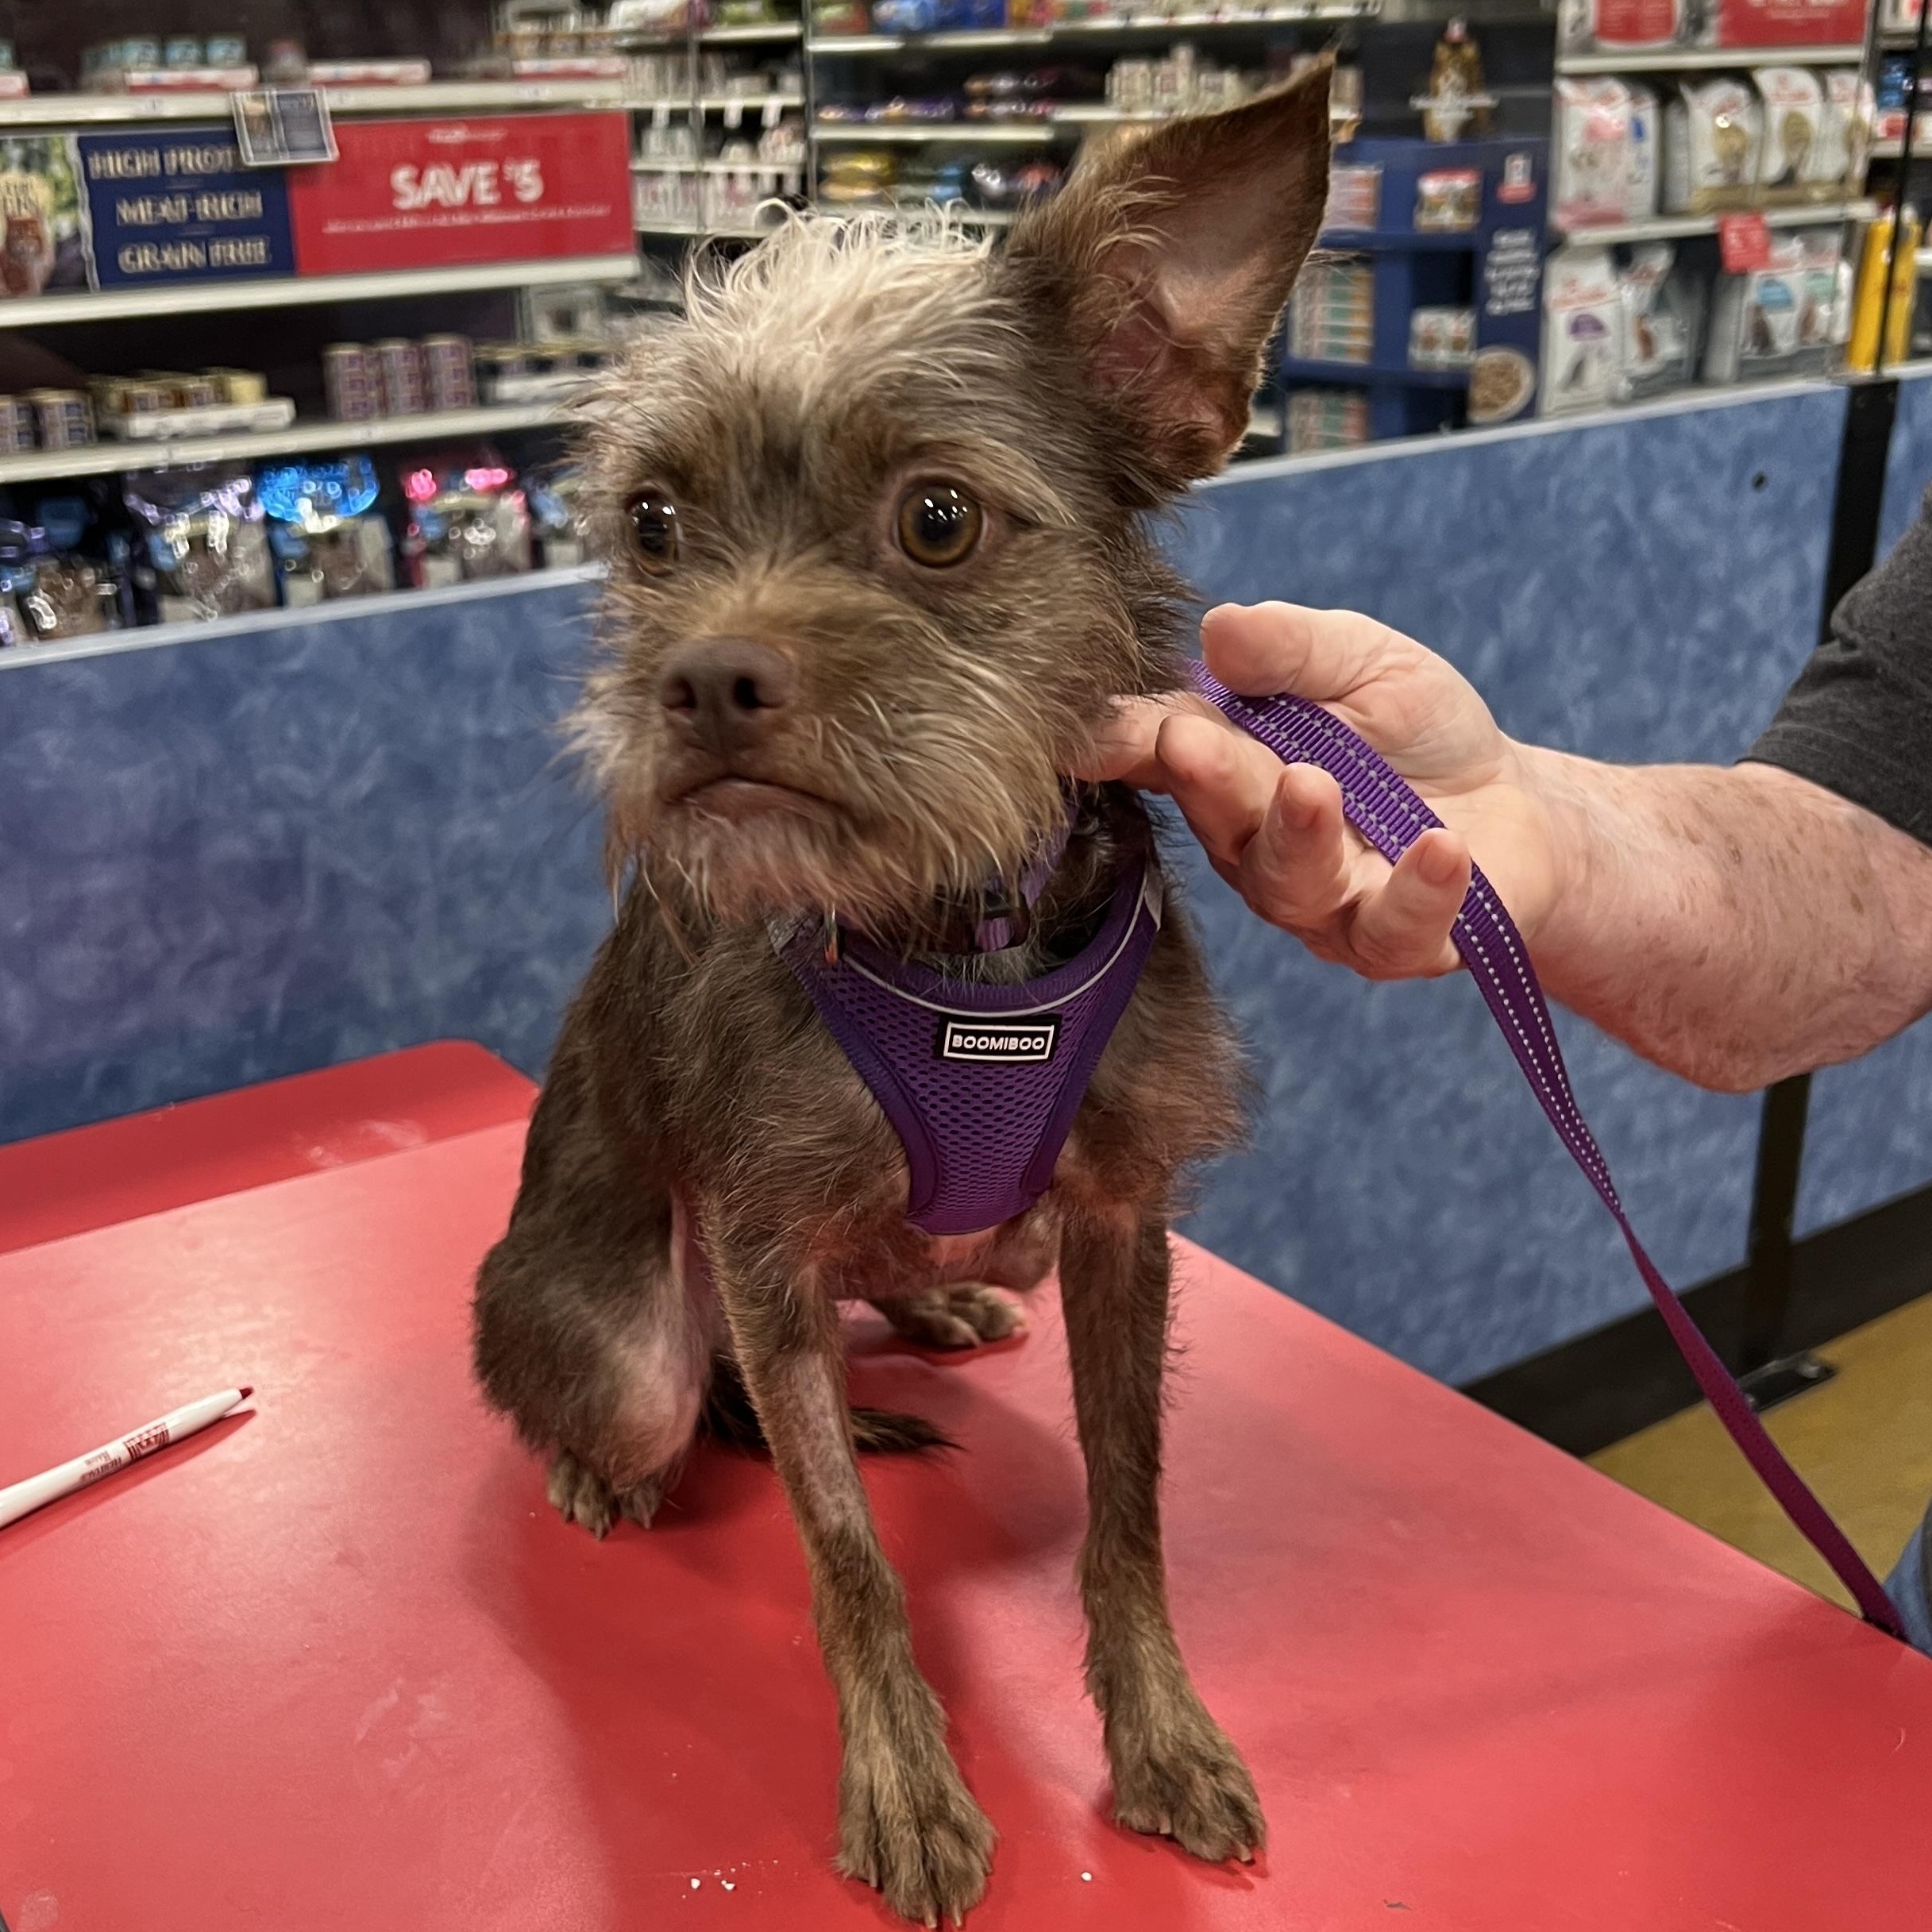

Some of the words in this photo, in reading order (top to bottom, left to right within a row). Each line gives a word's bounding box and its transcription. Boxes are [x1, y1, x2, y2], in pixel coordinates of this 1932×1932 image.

[88, 148, 161, 179] HIGH
[164, 144, 241, 175] PROT
[390, 160, 502, 210] SAVE
[503, 158, 545, 203] $5
[118, 241, 207, 274] GRAIN
[209, 236, 272, 268] FREE
[952, 1035, 1045, 1050] BOOMIBOO
